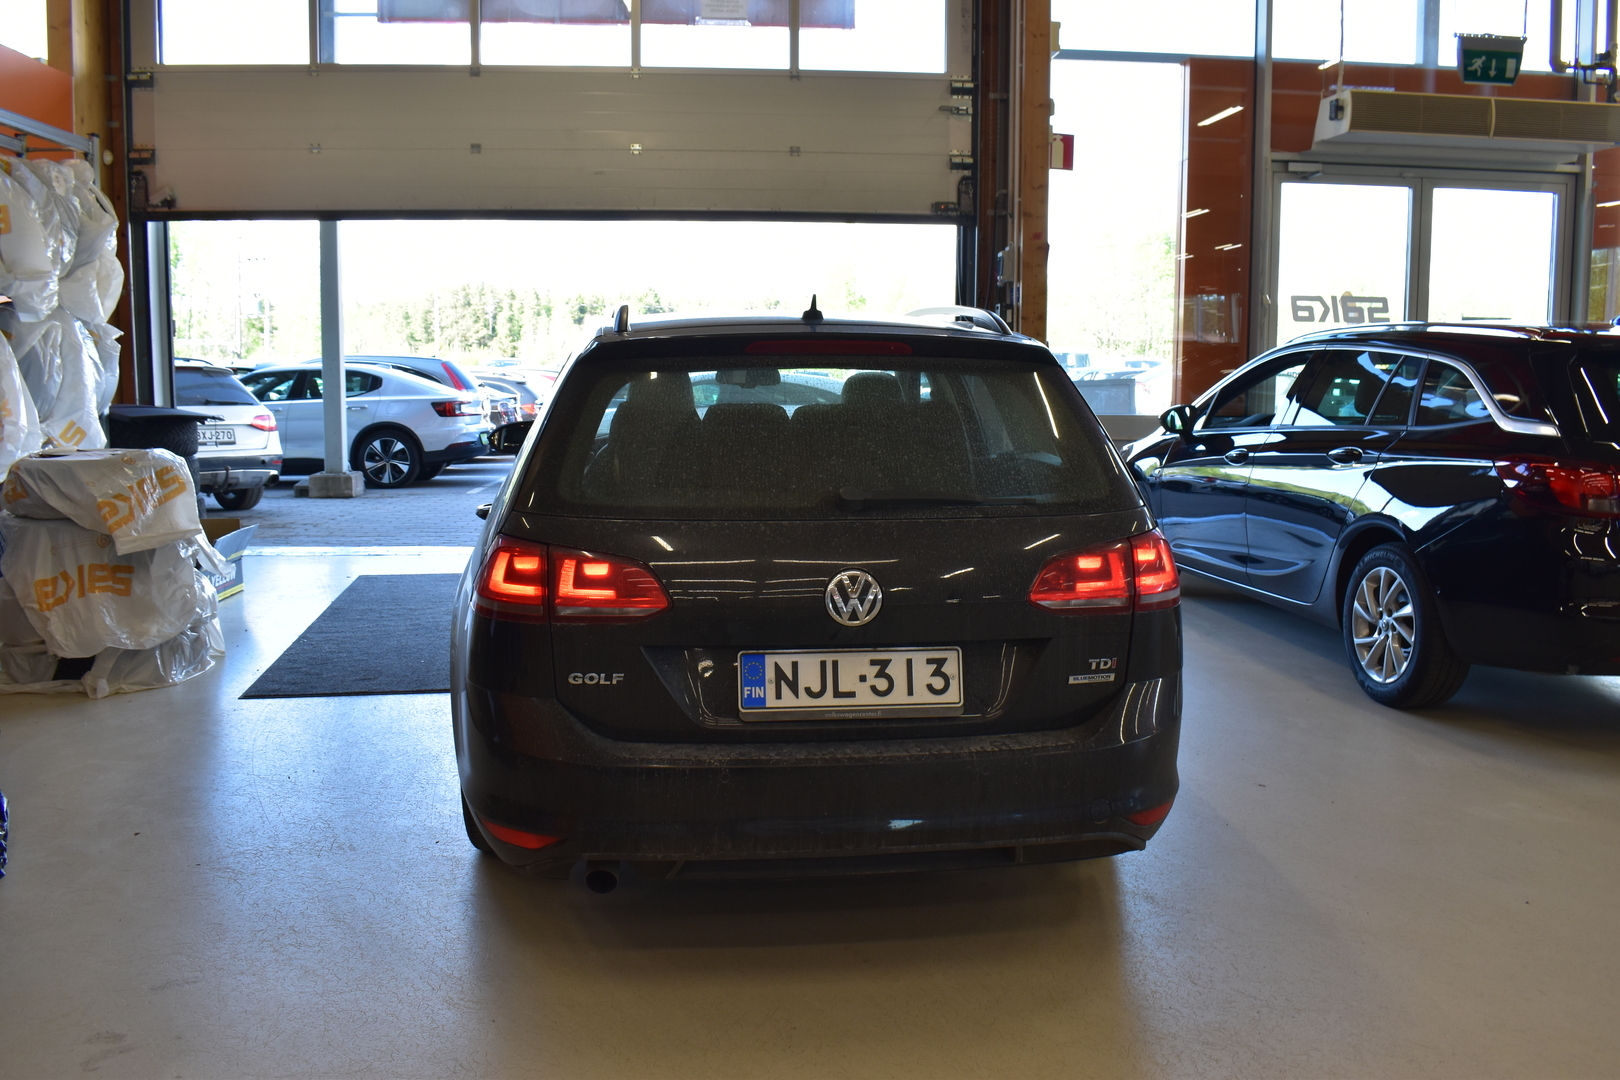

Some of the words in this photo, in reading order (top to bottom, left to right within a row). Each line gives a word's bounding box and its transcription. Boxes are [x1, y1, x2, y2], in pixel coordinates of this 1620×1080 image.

[1088, 658, 1117, 670] TDI
[568, 672, 625, 685] GOLF
[774, 657, 951, 700] NJL-313
[1072, 674, 1111, 682] BLUEMOTION
[744, 686, 765, 698] FIN
[824, 710, 882, 719] volkswagencenter.fi
